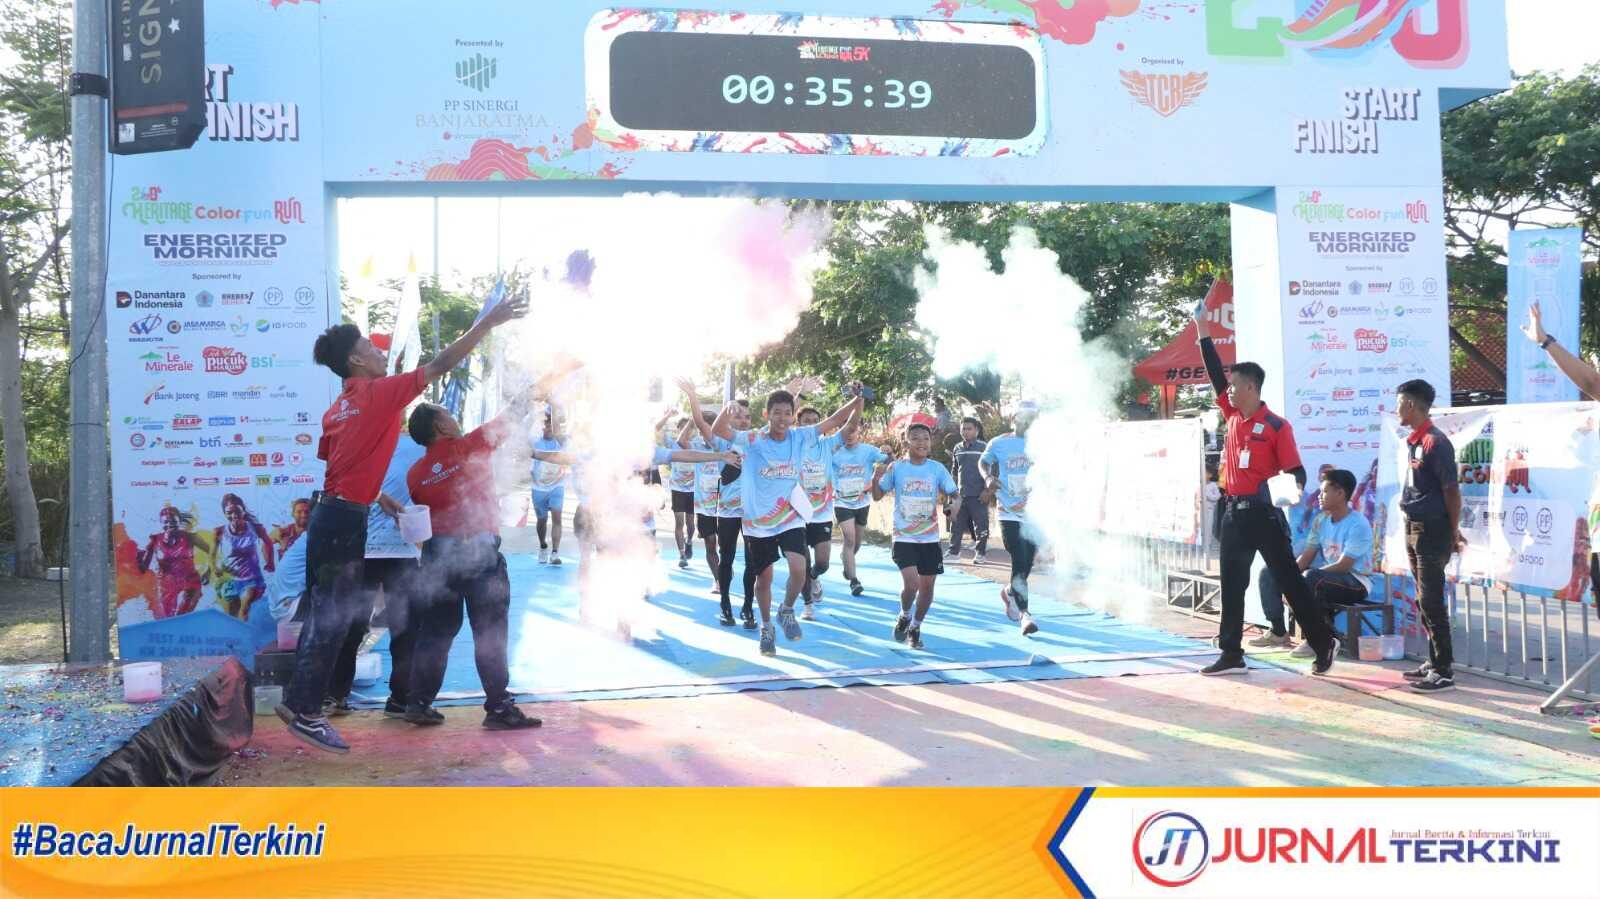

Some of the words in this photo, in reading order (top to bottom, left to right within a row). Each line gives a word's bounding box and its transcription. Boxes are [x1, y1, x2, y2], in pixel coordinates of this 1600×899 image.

[455, 38, 492, 47] Presented
[494, 39, 505, 48] by
[1176, 58, 1185, 66] by
[1147, 74, 1183, 113] TCR
[444, 100, 460, 111] PP
[463, 100, 519, 111] SINERGI
[1344, 88, 1421, 121] START
[205, 102, 299, 142] INISH
[415, 113, 549, 128] BANJARATMA
[1295, 120, 1379, 154] FINISH
[122, 202, 193, 225] HERITAGE
[195, 206, 241, 219] Color
[1346, 208, 1381, 220] Color
[143, 234, 288, 248] ENERGIZED
[1309, 231, 1416, 242] ENERGIZED
[153, 246, 278, 259] MORNING
[1316, 242, 1410, 253] MORNING
[192, 273, 230, 282] Sponsored
[231, 273, 242, 282] by
[1302, 280, 1341, 288] Danantara
[134, 289, 186, 299] Danantara
[1302, 288, 1339, 296] Indonesia
[134, 299, 184, 309] Indonesia
[166, 352, 180, 362] Le
[251, 357, 273, 368] BSI
[145, 361, 194, 372] Minerale
[154, 391, 174, 400] Bank
[199, 436, 221, 448] btn
